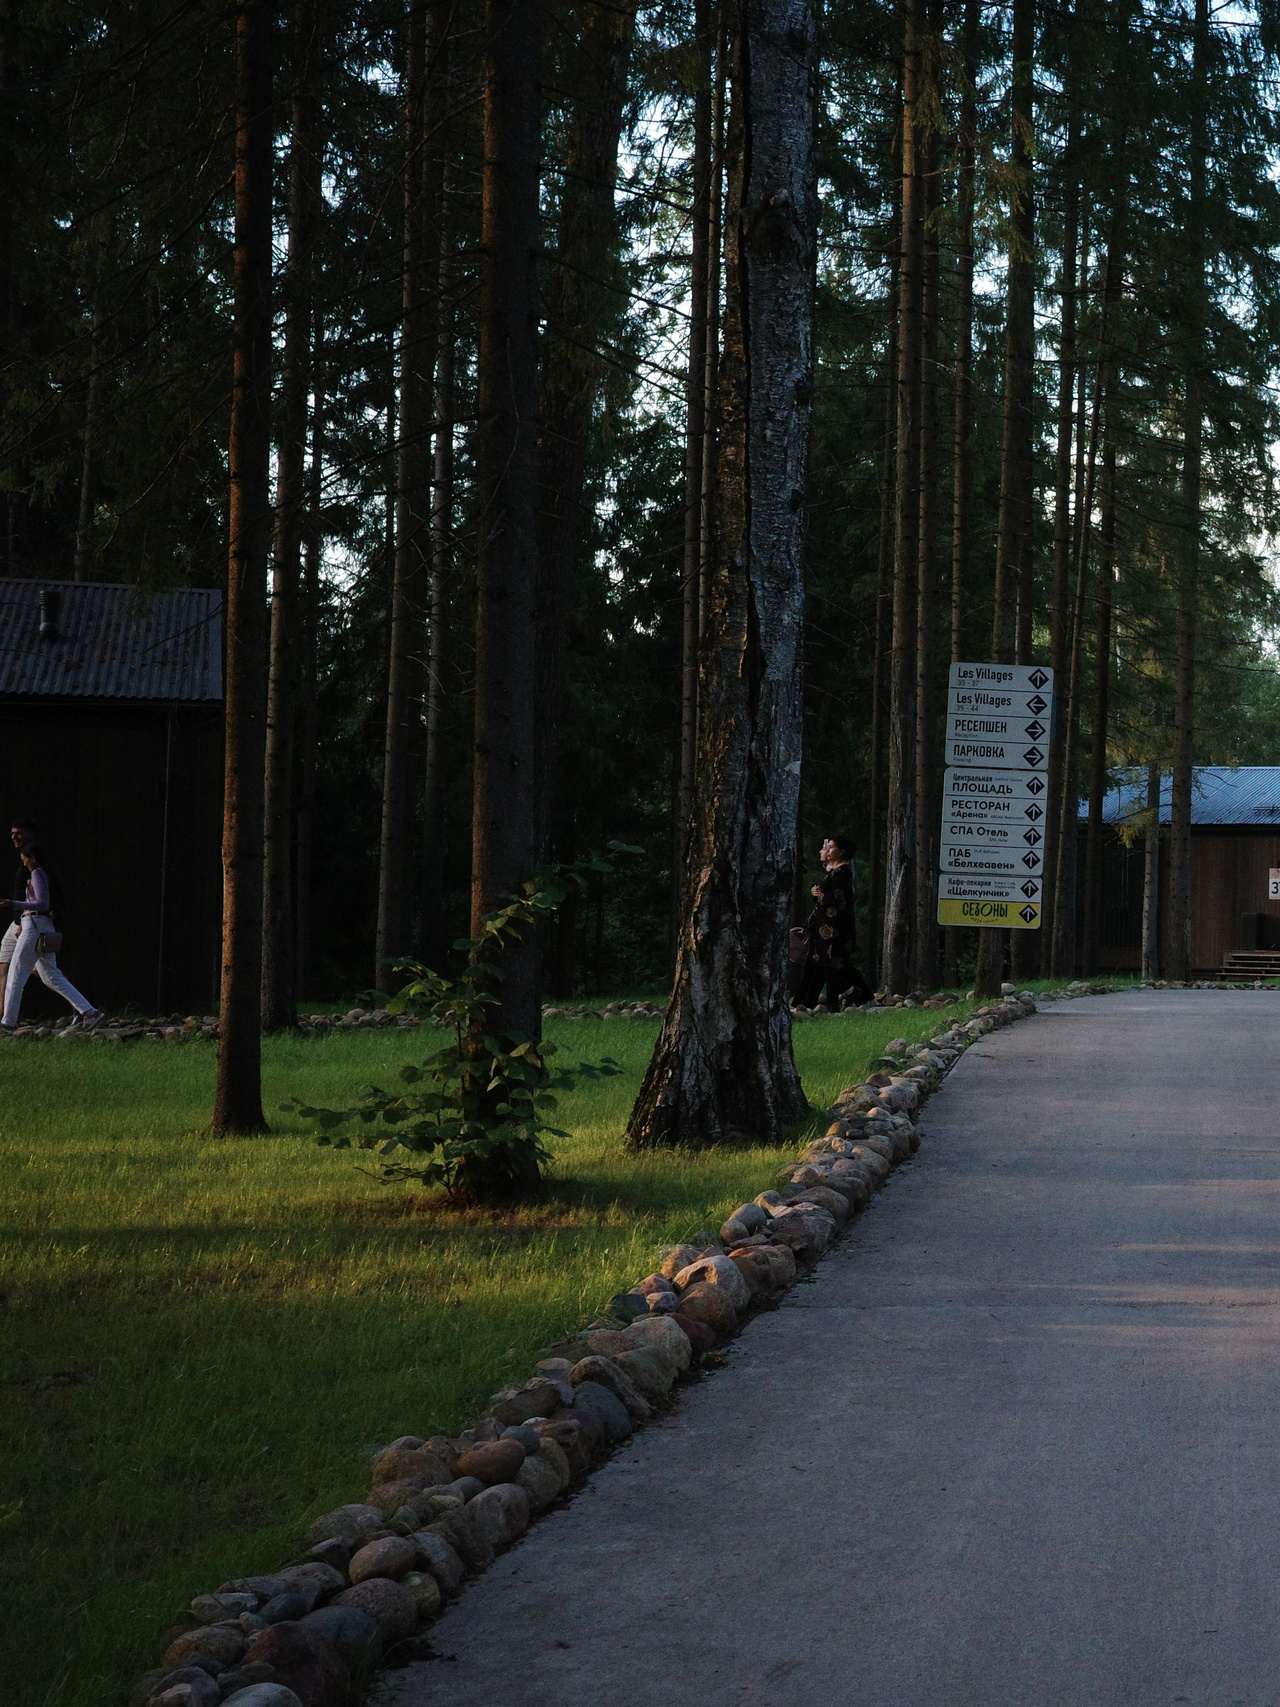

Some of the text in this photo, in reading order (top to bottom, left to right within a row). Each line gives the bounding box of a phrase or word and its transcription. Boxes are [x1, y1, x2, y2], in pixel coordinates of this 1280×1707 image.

[958, 667, 1013, 683] Les Villages
[957, 693, 1011, 708] Les Villages
[955, 720, 1007, 733] РЕСЕПШЕН
[953, 744, 1005, 758] ПАРКОВКА
[953, 774, 992, 782] Центральная
[952, 783, 1013, 794] ПЛОЩАДЬ
[951, 800, 1010, 811] РЕСТОРАН
[951, 810, 988, 819] «Арена»
[950, 826, 1008, 836] СПА Отель
[949, 848, 971, 858] ПАБ
[948, 859, 1015, 869] «Белхеавен»
[947, 887, 1009, 898] «Щелкунчик»
[962, 902, 1008, 918] СЕЗОНЫ
